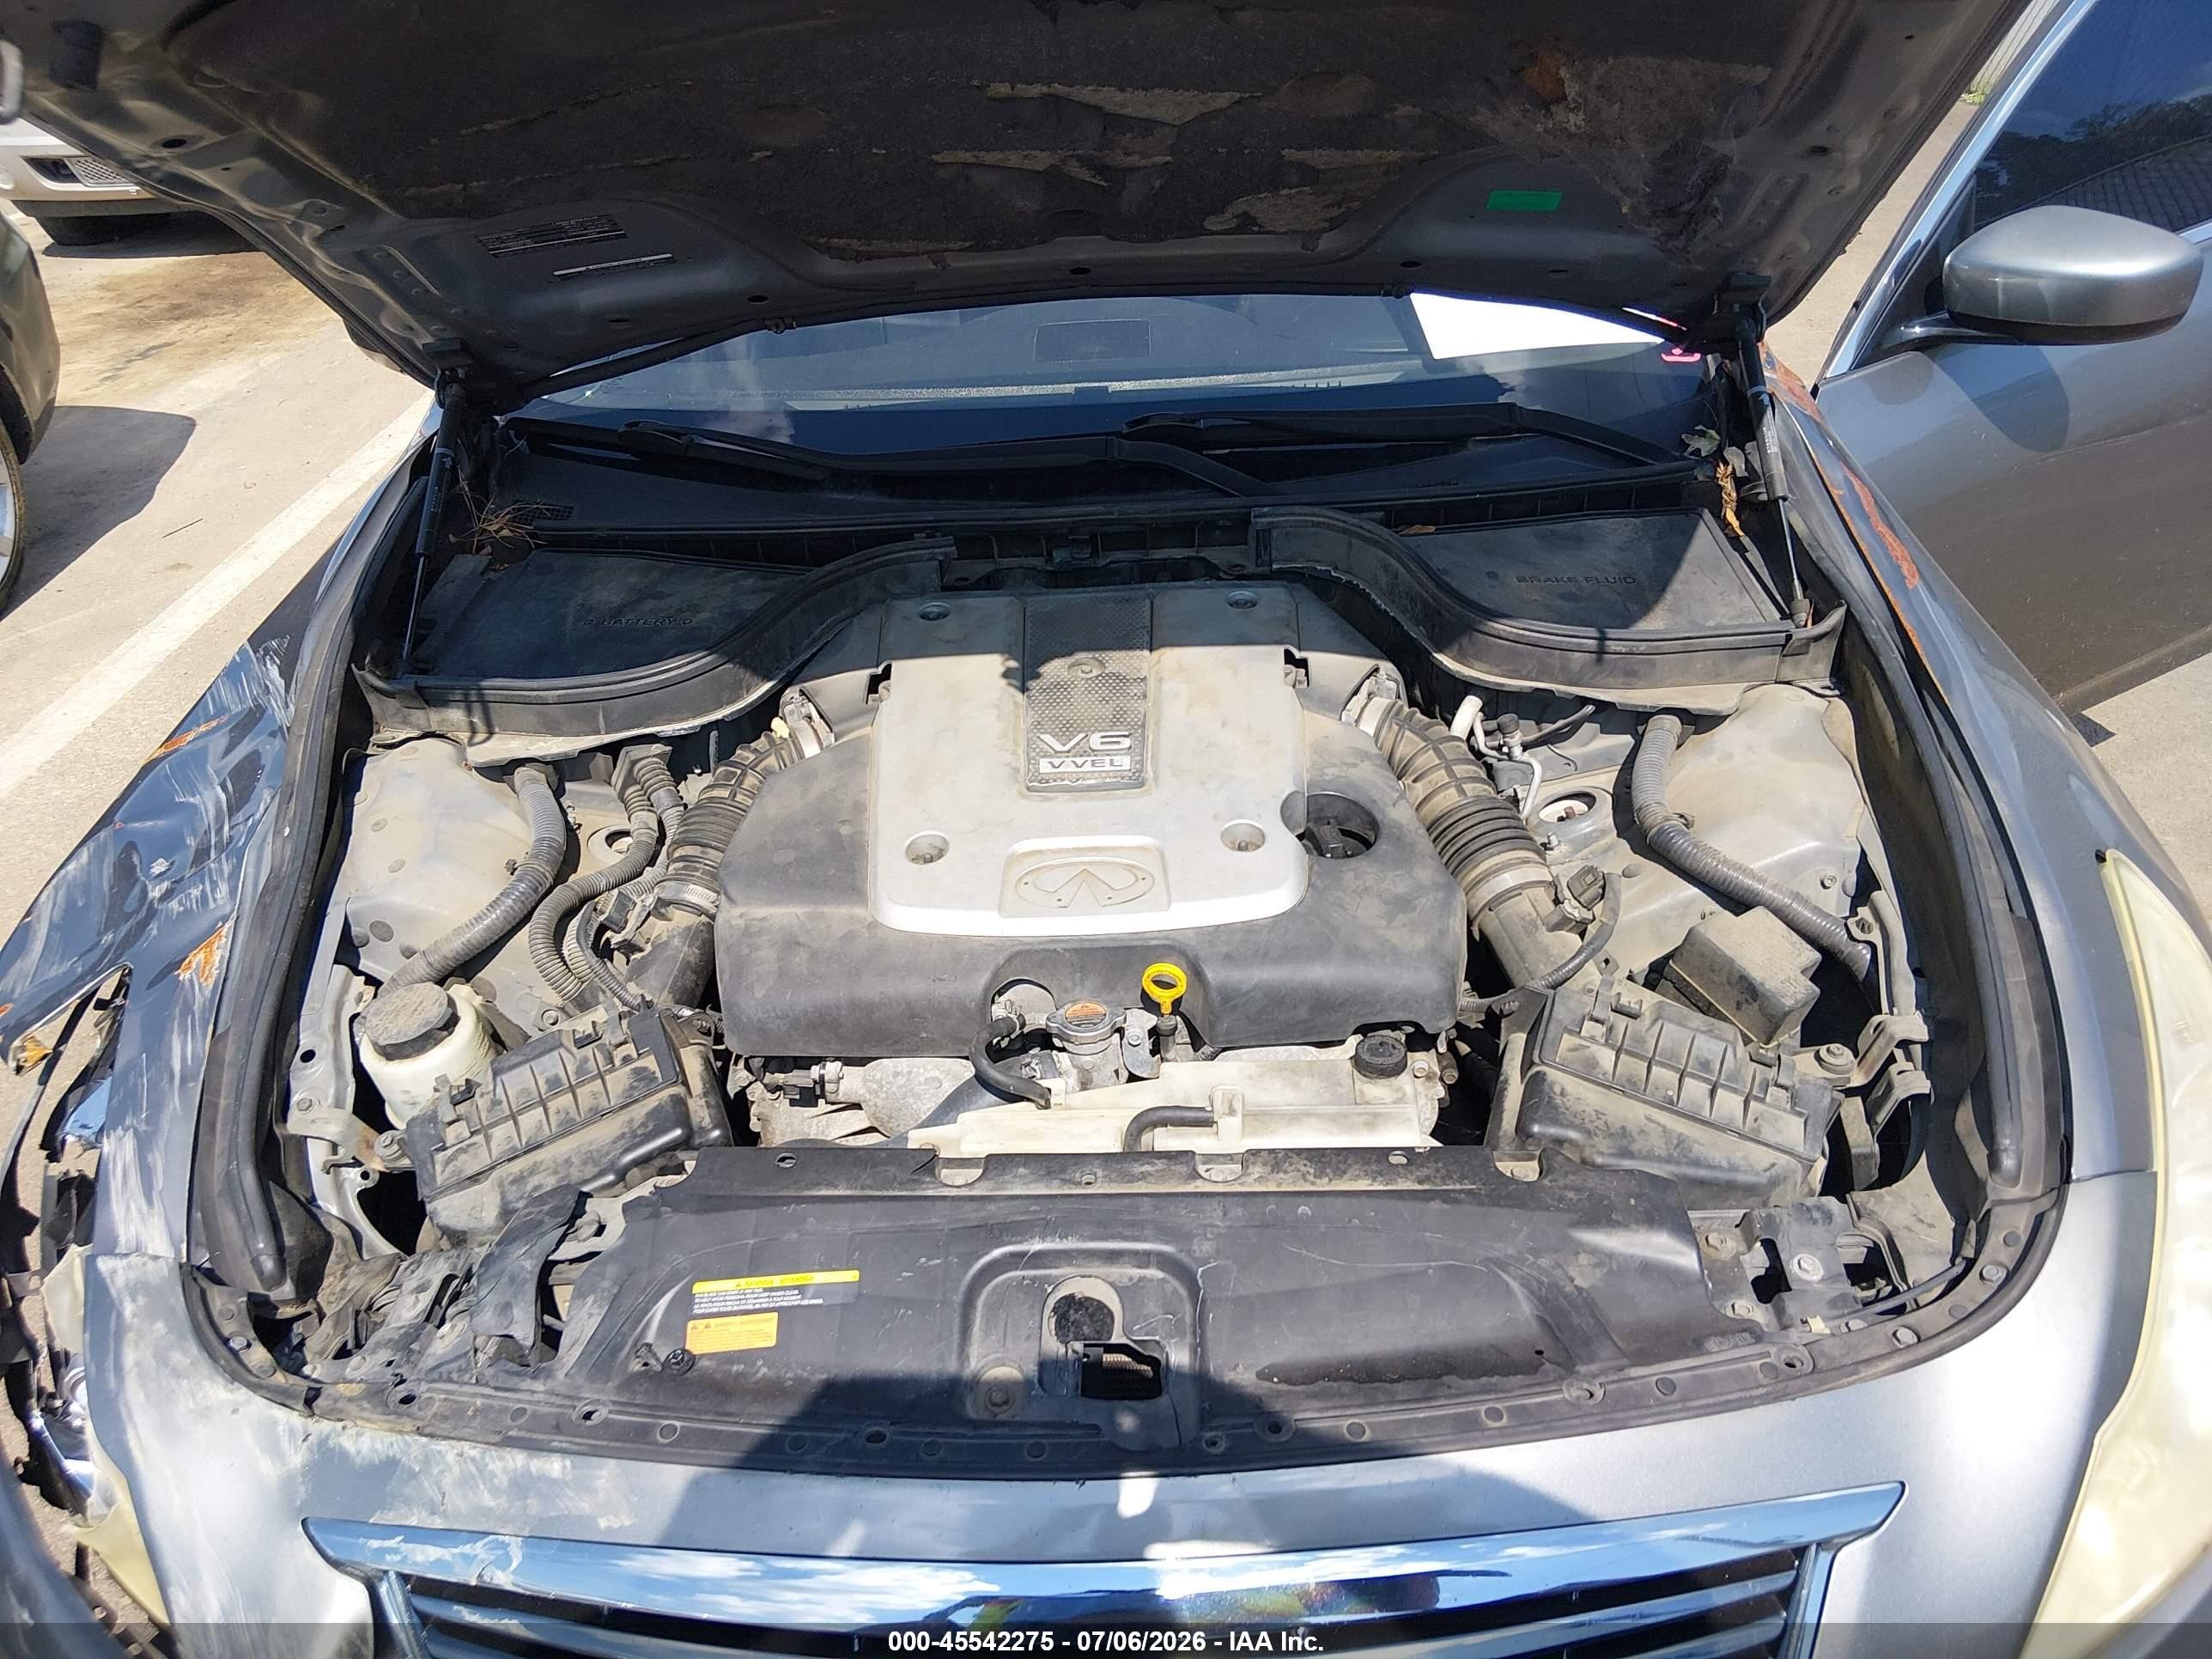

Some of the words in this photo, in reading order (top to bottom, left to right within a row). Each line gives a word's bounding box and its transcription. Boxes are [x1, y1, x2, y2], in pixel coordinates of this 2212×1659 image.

[1515, 575, 1580, 584] BRAKE
[1584, 575, 1637, 584] FLUID
[601, 617, 676, 626] BATTERY
[1037, 731, 1132, 753] V6
[1047, 758, 1123, 769] VVEL
